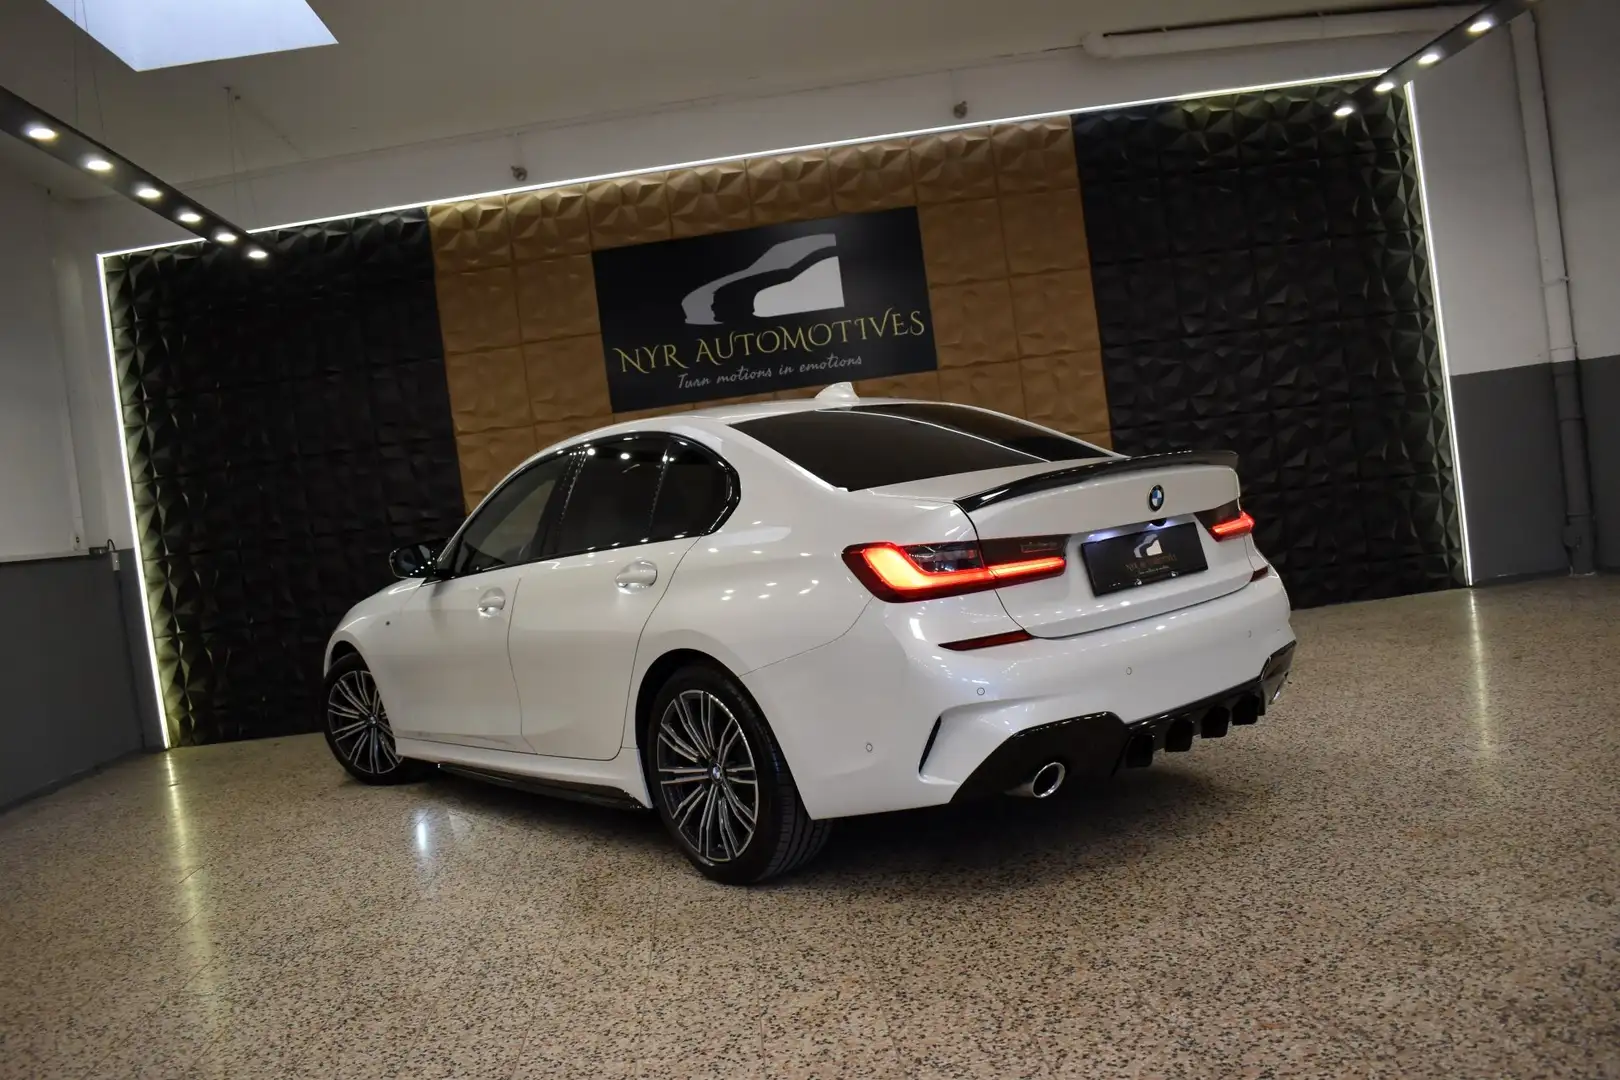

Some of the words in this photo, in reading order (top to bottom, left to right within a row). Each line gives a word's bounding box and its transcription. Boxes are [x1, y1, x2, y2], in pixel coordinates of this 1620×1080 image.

[613, 344, 690, 374] NYR
[695, 308, 925, 366] AUTOMOTIVES
[677, 373, 711, 389] Turn
[716, 365, 774, 385] motions
[778, 363, 795, 376] in
[799, 352, 863, 373] emotions
